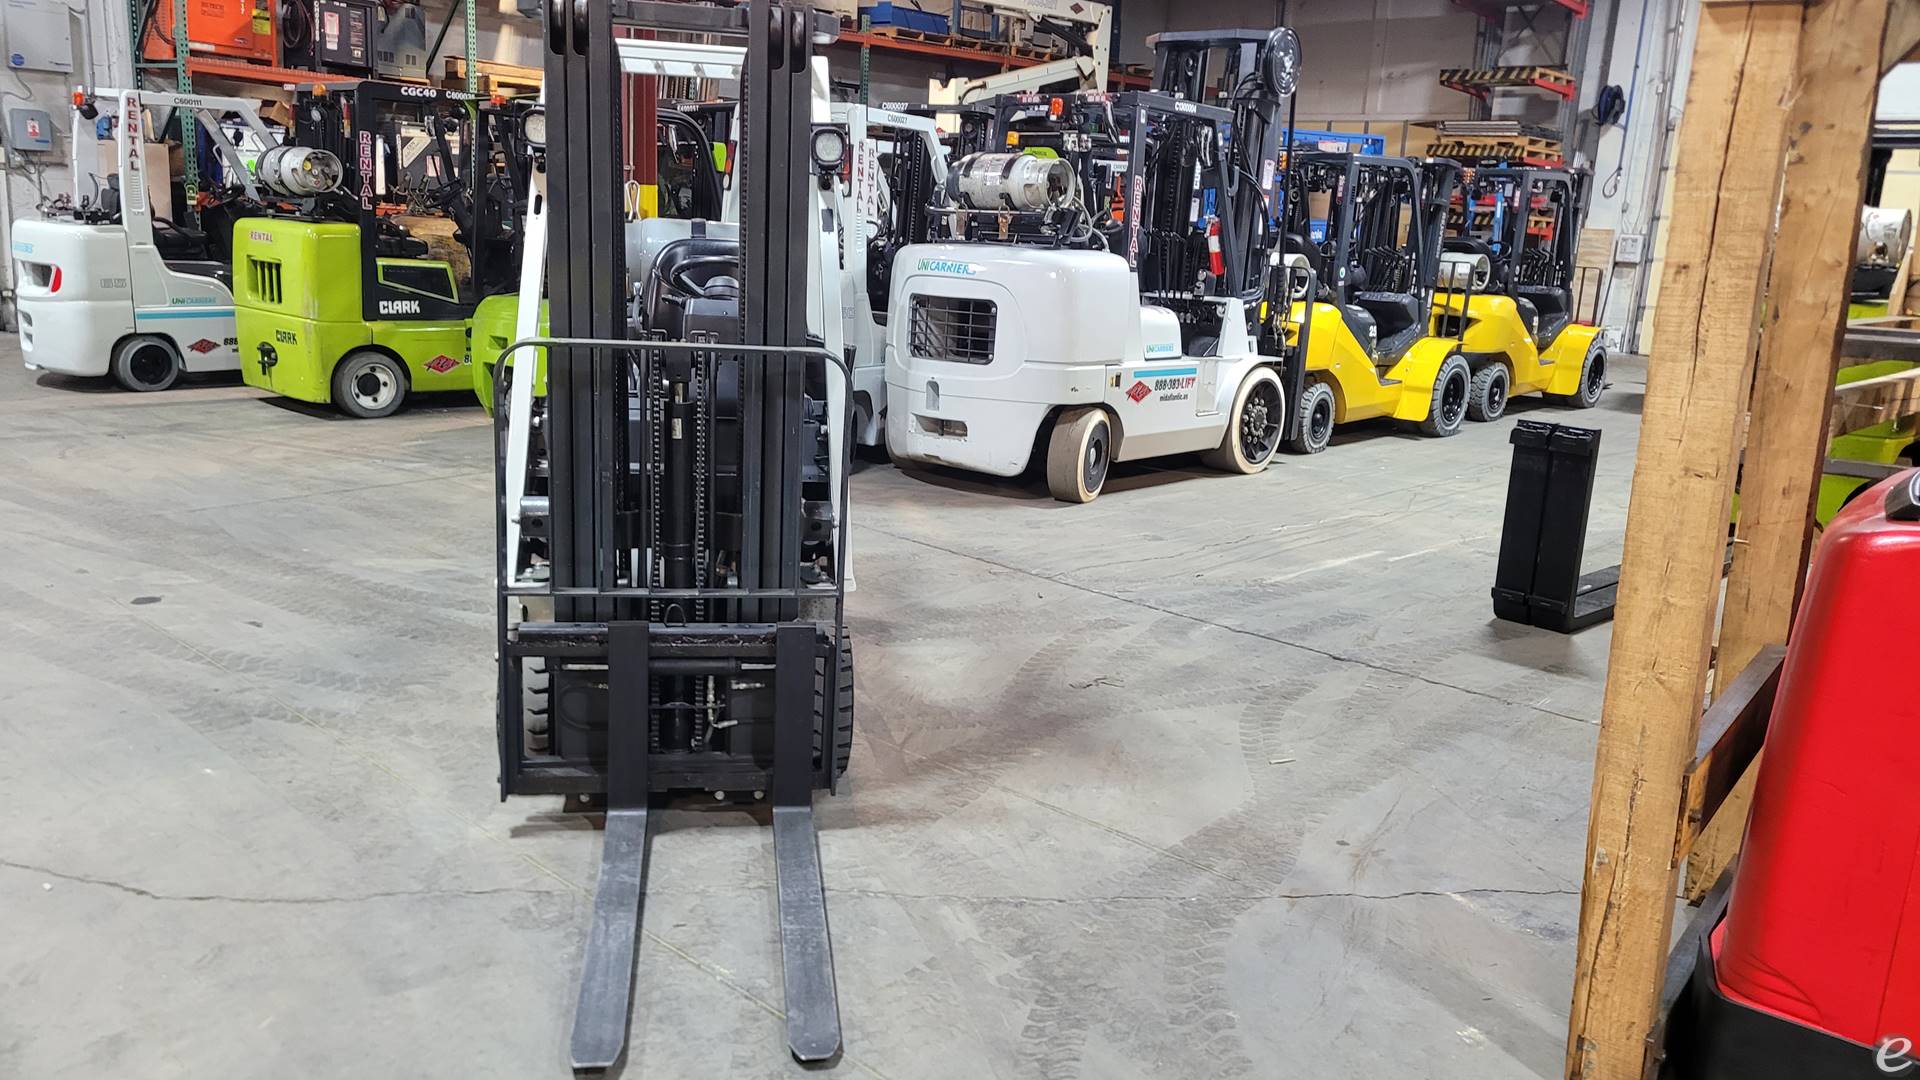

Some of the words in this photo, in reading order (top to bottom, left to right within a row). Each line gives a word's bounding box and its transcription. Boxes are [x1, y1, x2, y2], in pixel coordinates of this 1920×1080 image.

[400, 86, 437, 98] CGC40
[126, 97, 140, 171] RENTAL
[359, 130, 374, 211] RENTAL
[856, 140, 865, 214] RENTAL
[867, 148, 876, 217] RENTAL
[250, 231, 273, 243] RENTAL
[1129, 174, 1143, 268] RENTAL
[917, 257, 977, 276] UNICARRIER
[378, 300, 421, 315] CLARK
[275, 329, 298, 345] CLARK
